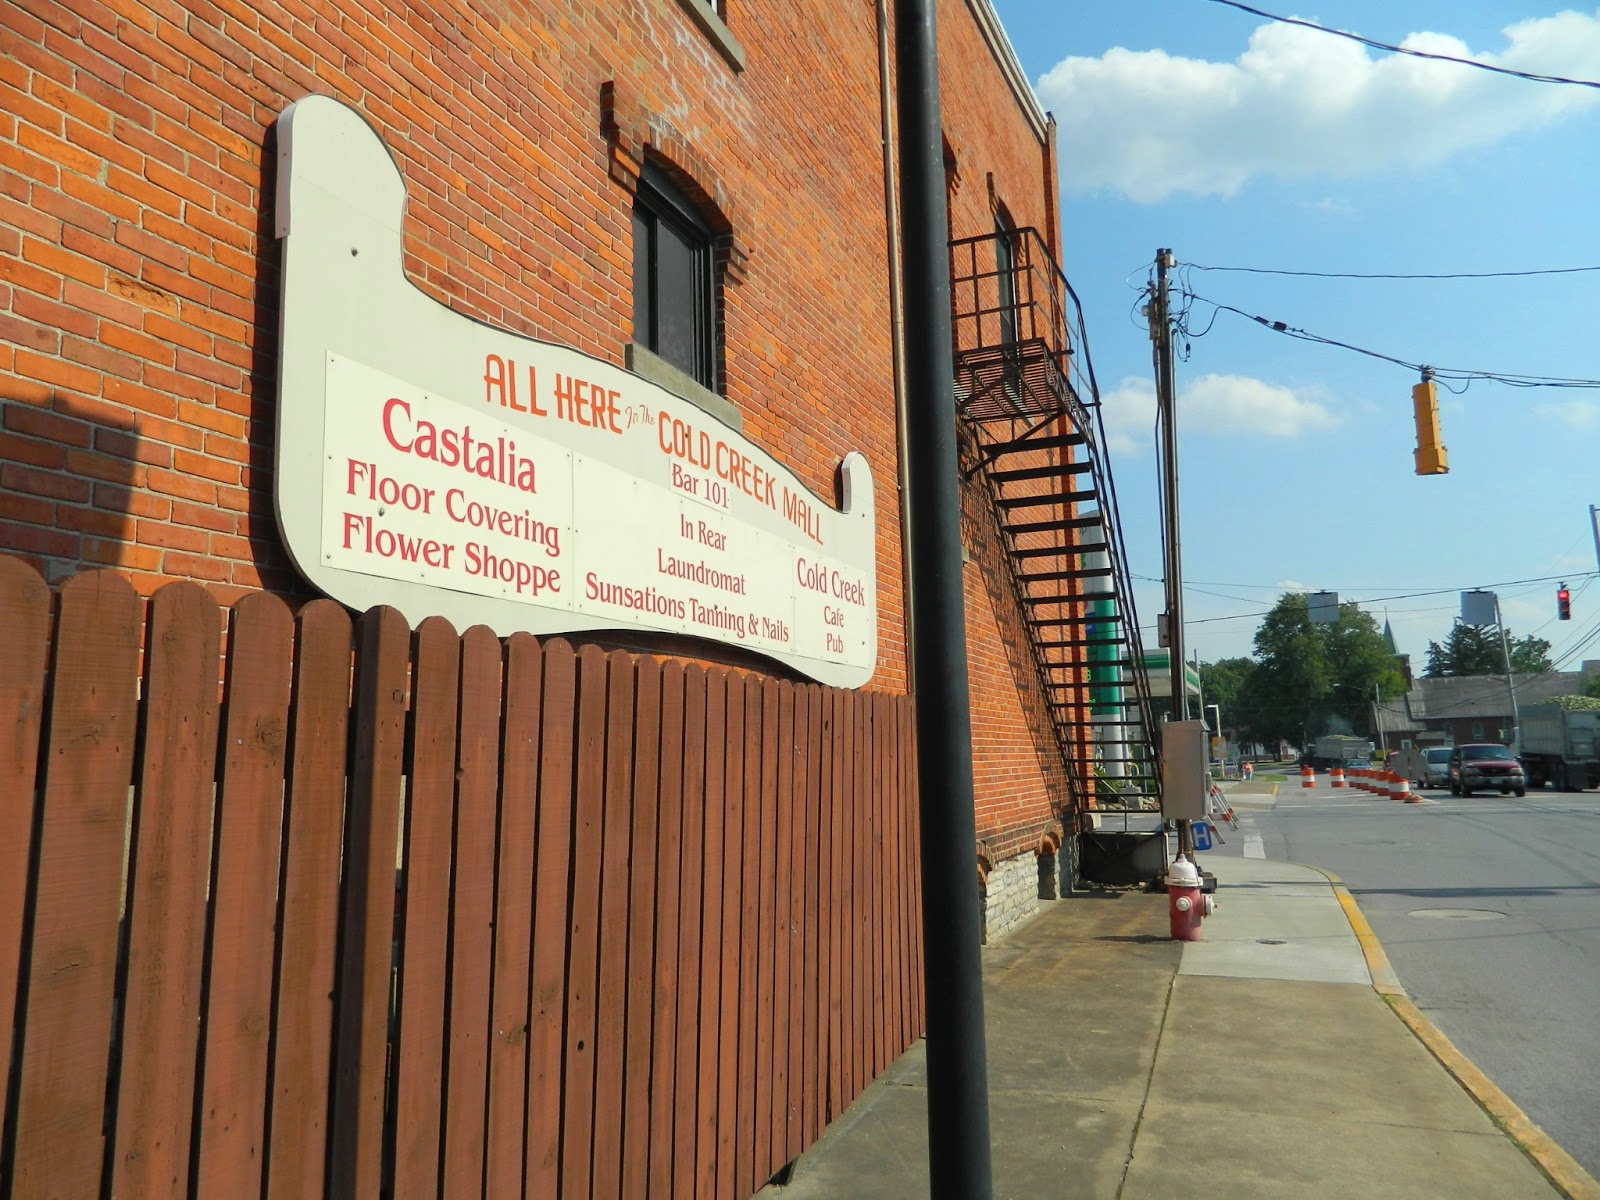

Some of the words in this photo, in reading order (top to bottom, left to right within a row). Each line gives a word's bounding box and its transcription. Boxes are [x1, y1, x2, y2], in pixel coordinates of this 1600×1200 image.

[382, 397, 537, 494] Castalia
[483, 353, 548, 417] ALL
[554, 373, 623, 435] HERE
[625, 406, 639, 429] In
[639, 404, 656, 426] The
[658, 410, 711, 471] COLD
[715, 441, 777, 511] CREEK
[783, 486, 824, 546] MALL
[346, 458, 436, 515] Floor
[445, 488, 561, 558] Covering
[672, 463, 699, 495] Bar
[704, 478, 730, 509] 101
[342, 512, 455, 570] Flower
[464, 541, 562, 597] Shoppe
[680, 513, 694, 540] In
[698, 520, 727, 551] Rear
[657, 548, 746, 596] Laundromat
[797, 558, 828, 594] Cold
[831, 570, 865, 606] Creek
[585, 572, 686, 619] Sunsations
[689, 597, 745, 639] Tanning
[748, 613, 759, 635] &
[762, 616, 789, 642] Nails
[824, 605, 845, 628] Cafe
[826, 632, 844, 654] Pub
[1192, 826, 1210, 848] H
